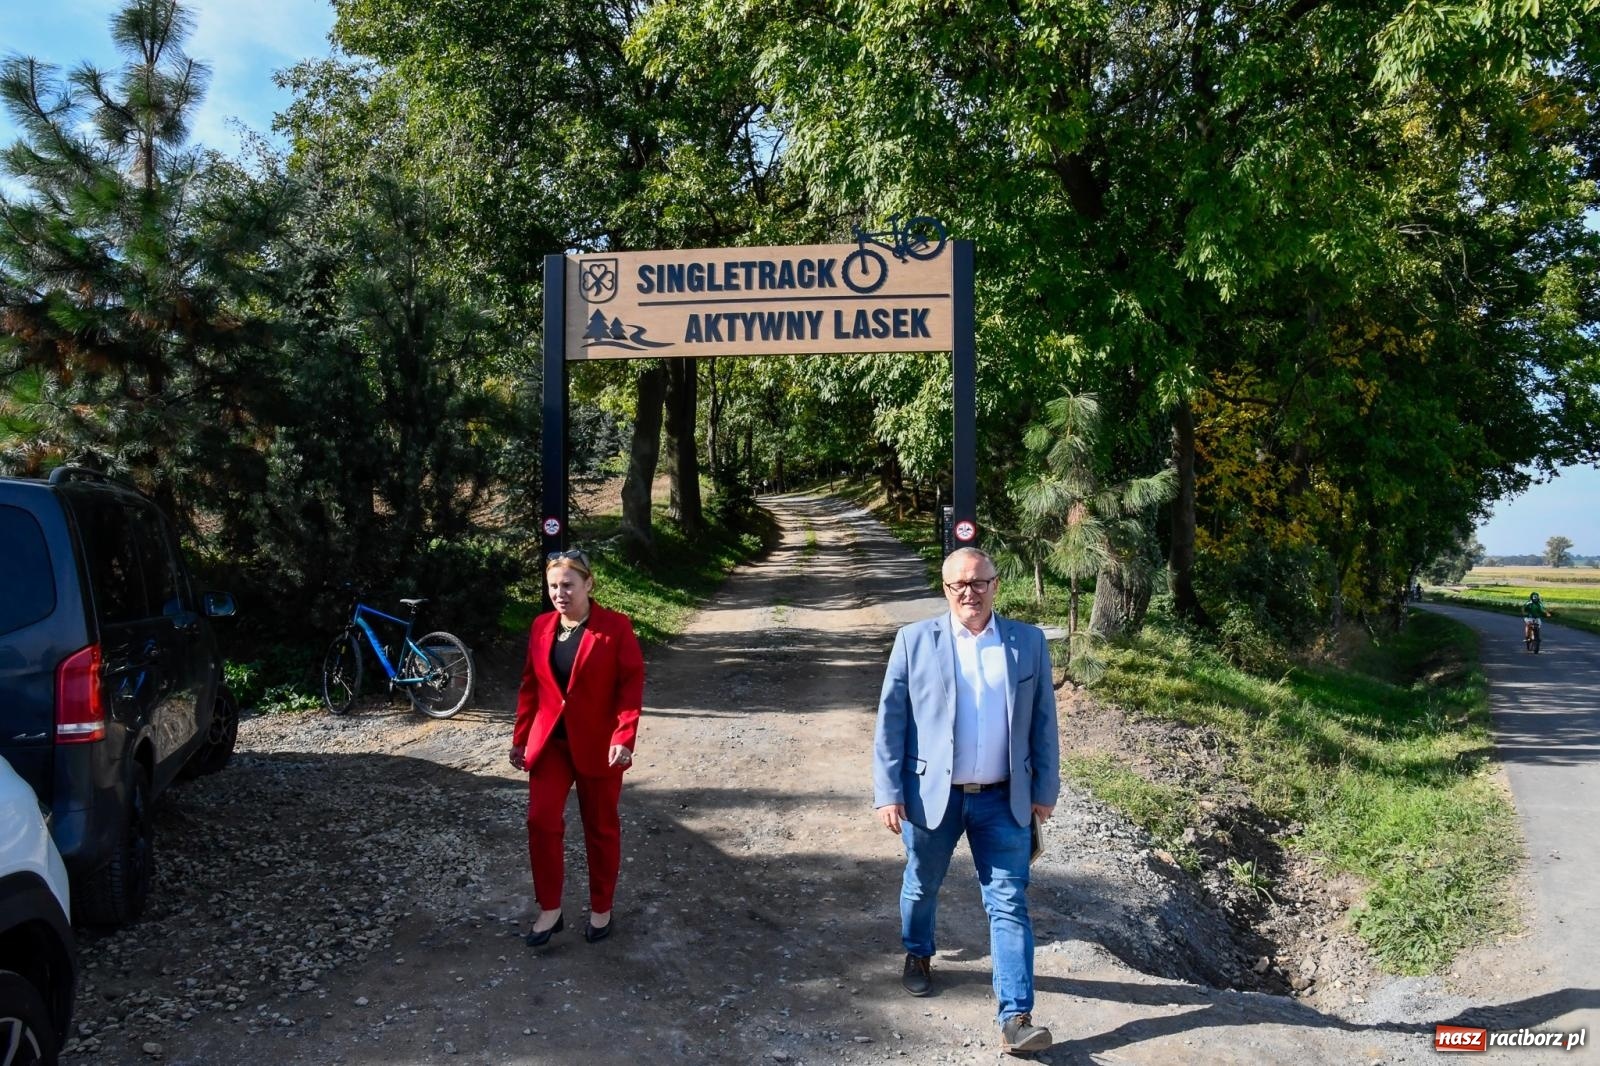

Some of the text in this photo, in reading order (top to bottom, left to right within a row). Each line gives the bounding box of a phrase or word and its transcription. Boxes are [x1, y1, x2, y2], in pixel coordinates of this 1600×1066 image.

[637, 258, 836, 294] SINGLETRACK
[684, 308, 932, 343] AKTYWNY LASEK
